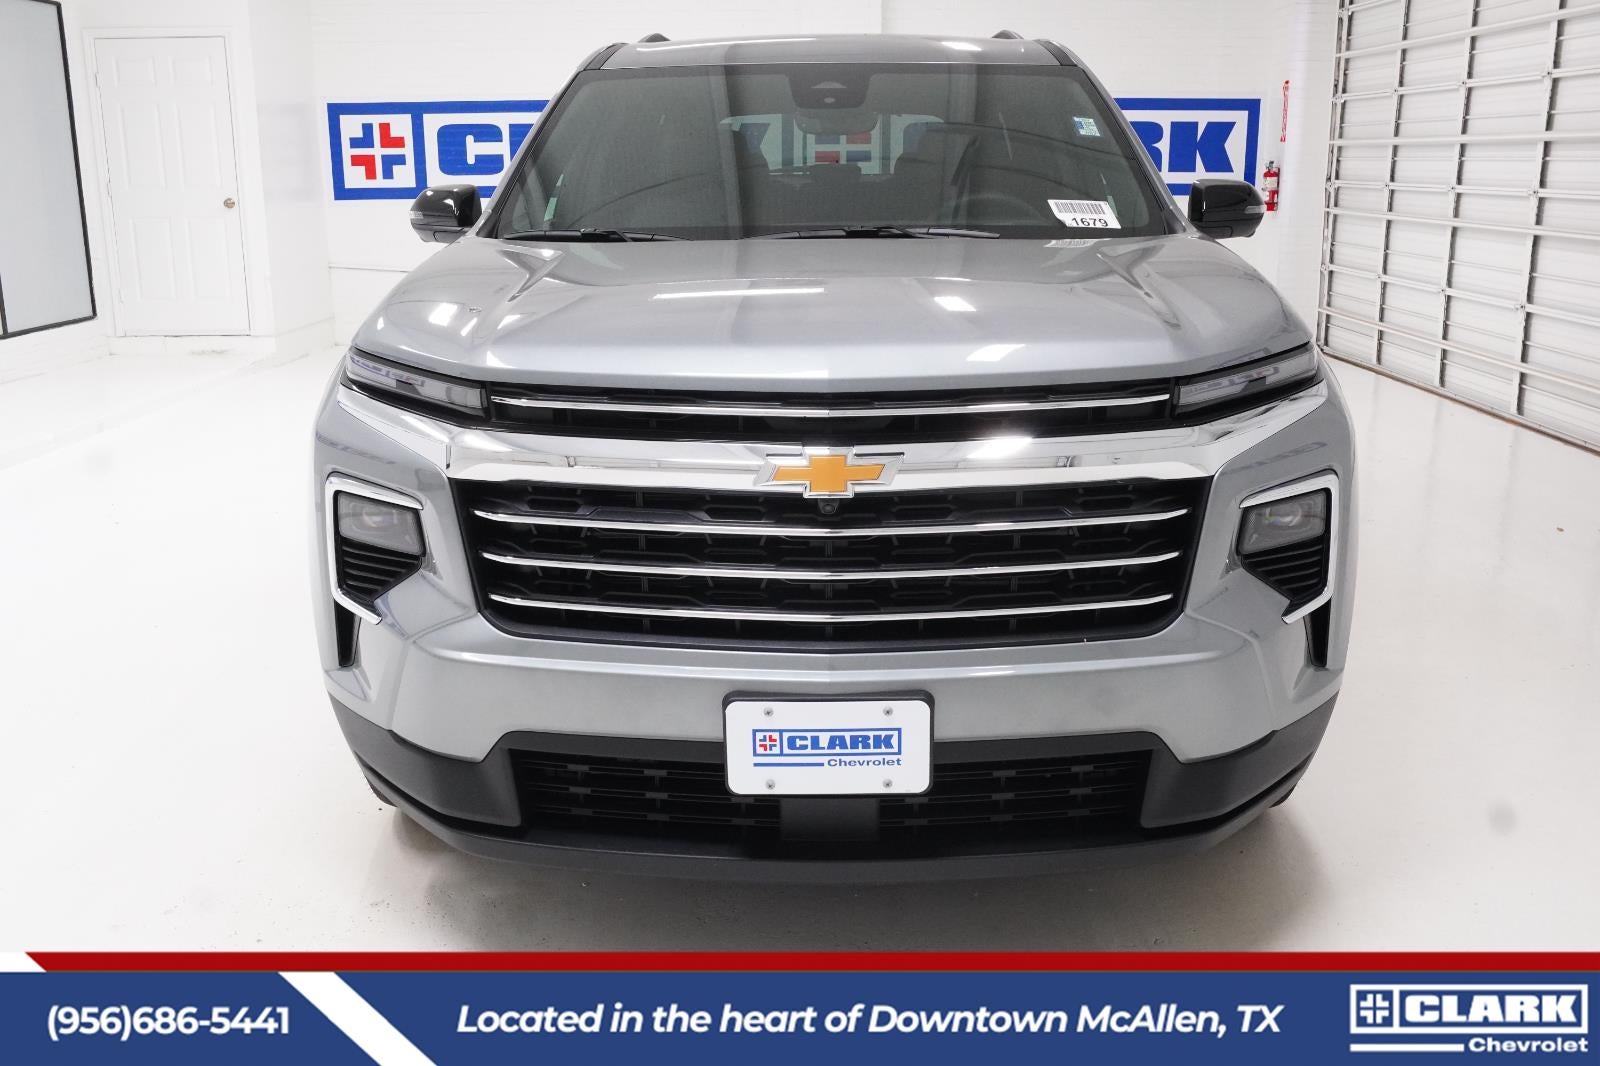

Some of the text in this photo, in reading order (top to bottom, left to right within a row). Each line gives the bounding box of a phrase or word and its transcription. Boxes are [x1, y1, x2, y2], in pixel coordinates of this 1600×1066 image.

[1071, 217, 1109, 228] 1679
[786, 734, 895, 751] CLARK
[827, 757, 902, 767] Chevrolet
